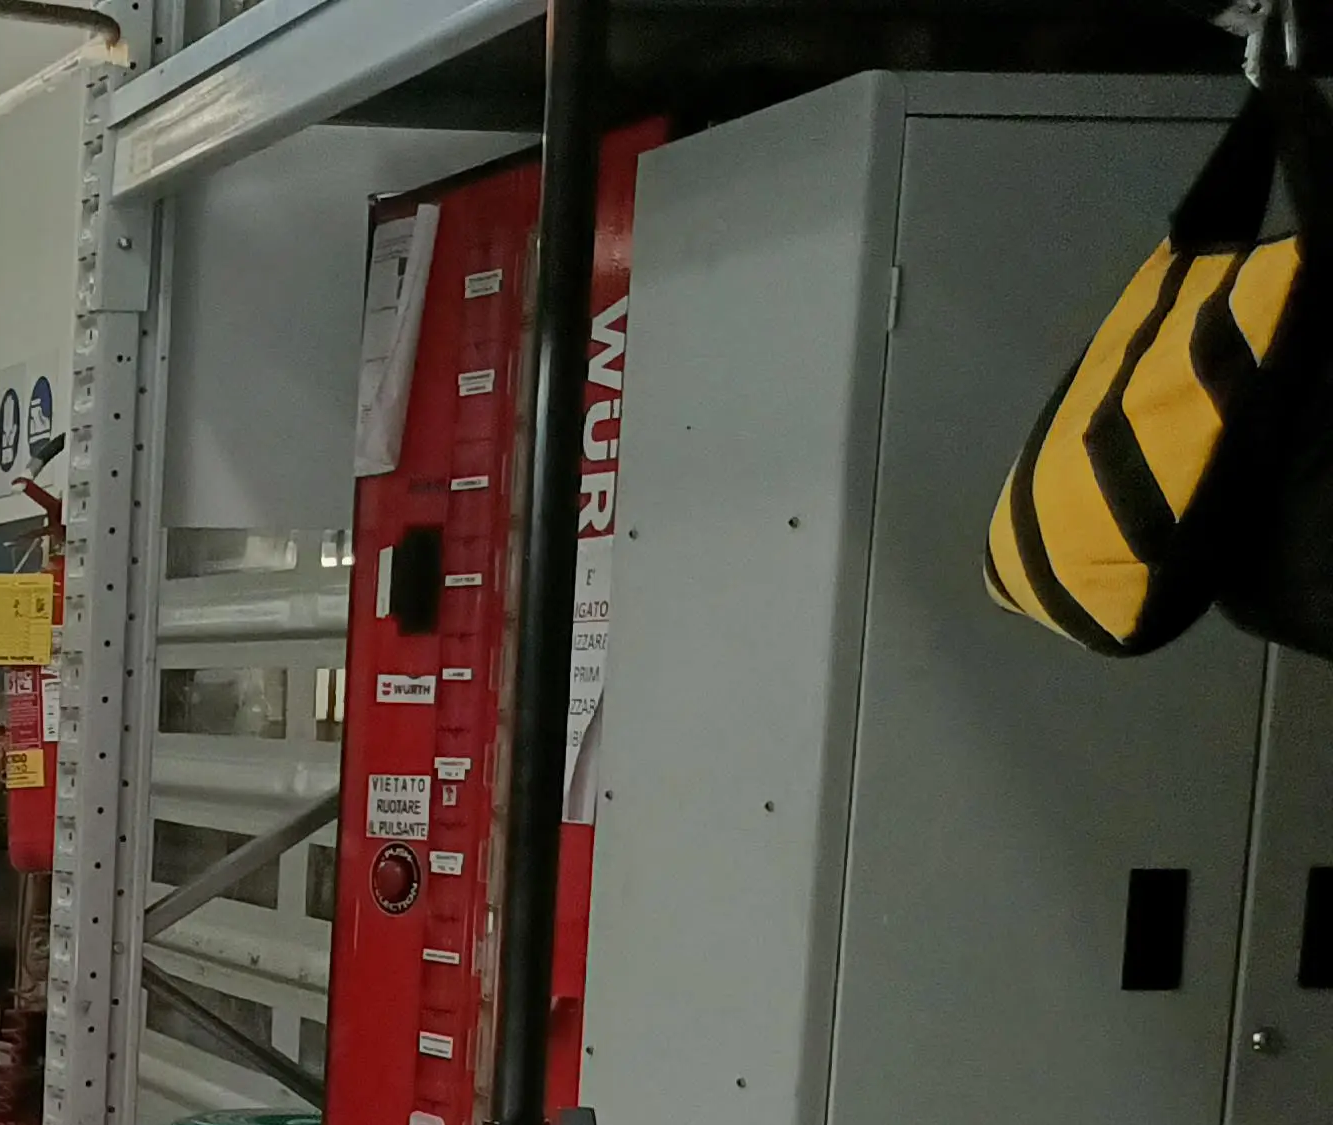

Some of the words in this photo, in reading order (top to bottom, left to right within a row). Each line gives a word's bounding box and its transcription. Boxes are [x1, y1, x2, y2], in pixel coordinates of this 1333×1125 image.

[371, 777, 426, 793] VIETATO
[376, 799, 422, 815] RUOTARE
[379, 821, 427, 837] PULSANTE
